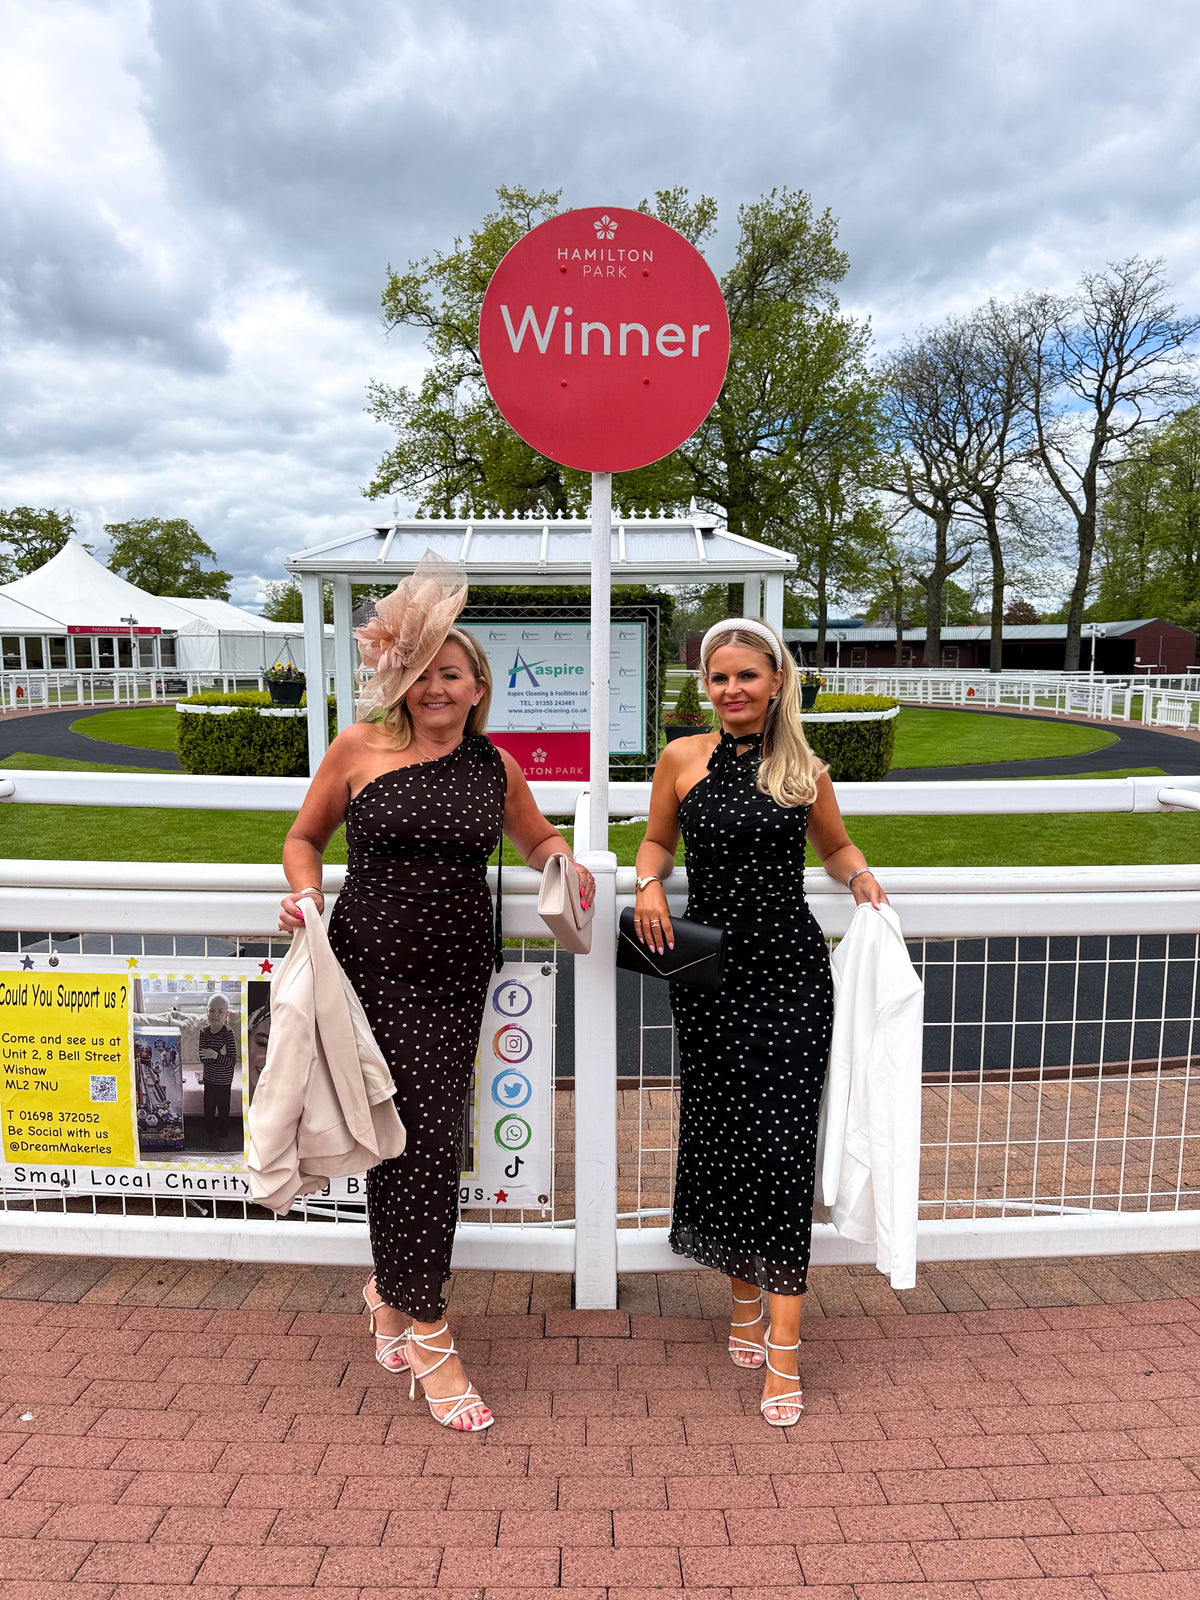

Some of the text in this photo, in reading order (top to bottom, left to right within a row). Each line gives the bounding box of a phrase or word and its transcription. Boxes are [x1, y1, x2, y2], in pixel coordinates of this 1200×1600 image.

[557, 248, 654, 262] HAMILTON
[583, 265, 627, 278] PARK
[500, 304, 711, 358] Winner
[507, 690, 524, 698] Aspire
[523, 767, 583, 775] LTON PARK
[0, 983, 127, 1013] Could You Support us ?
[1, 1033, 121, 1046] Come and see us at
[2, 1048, 121, 1062] Unit 2, 8 Bell Street
[3, 1064, 46, 1075] Wishaw
[5, 1080, 58, 1091] ML2 7NU
[6, 1110, 100, 1123] T 01698 372052
[8, 1126, 109, 1139] Be Social with us
[14, 1167, 249, 1194] Small Local Charity
